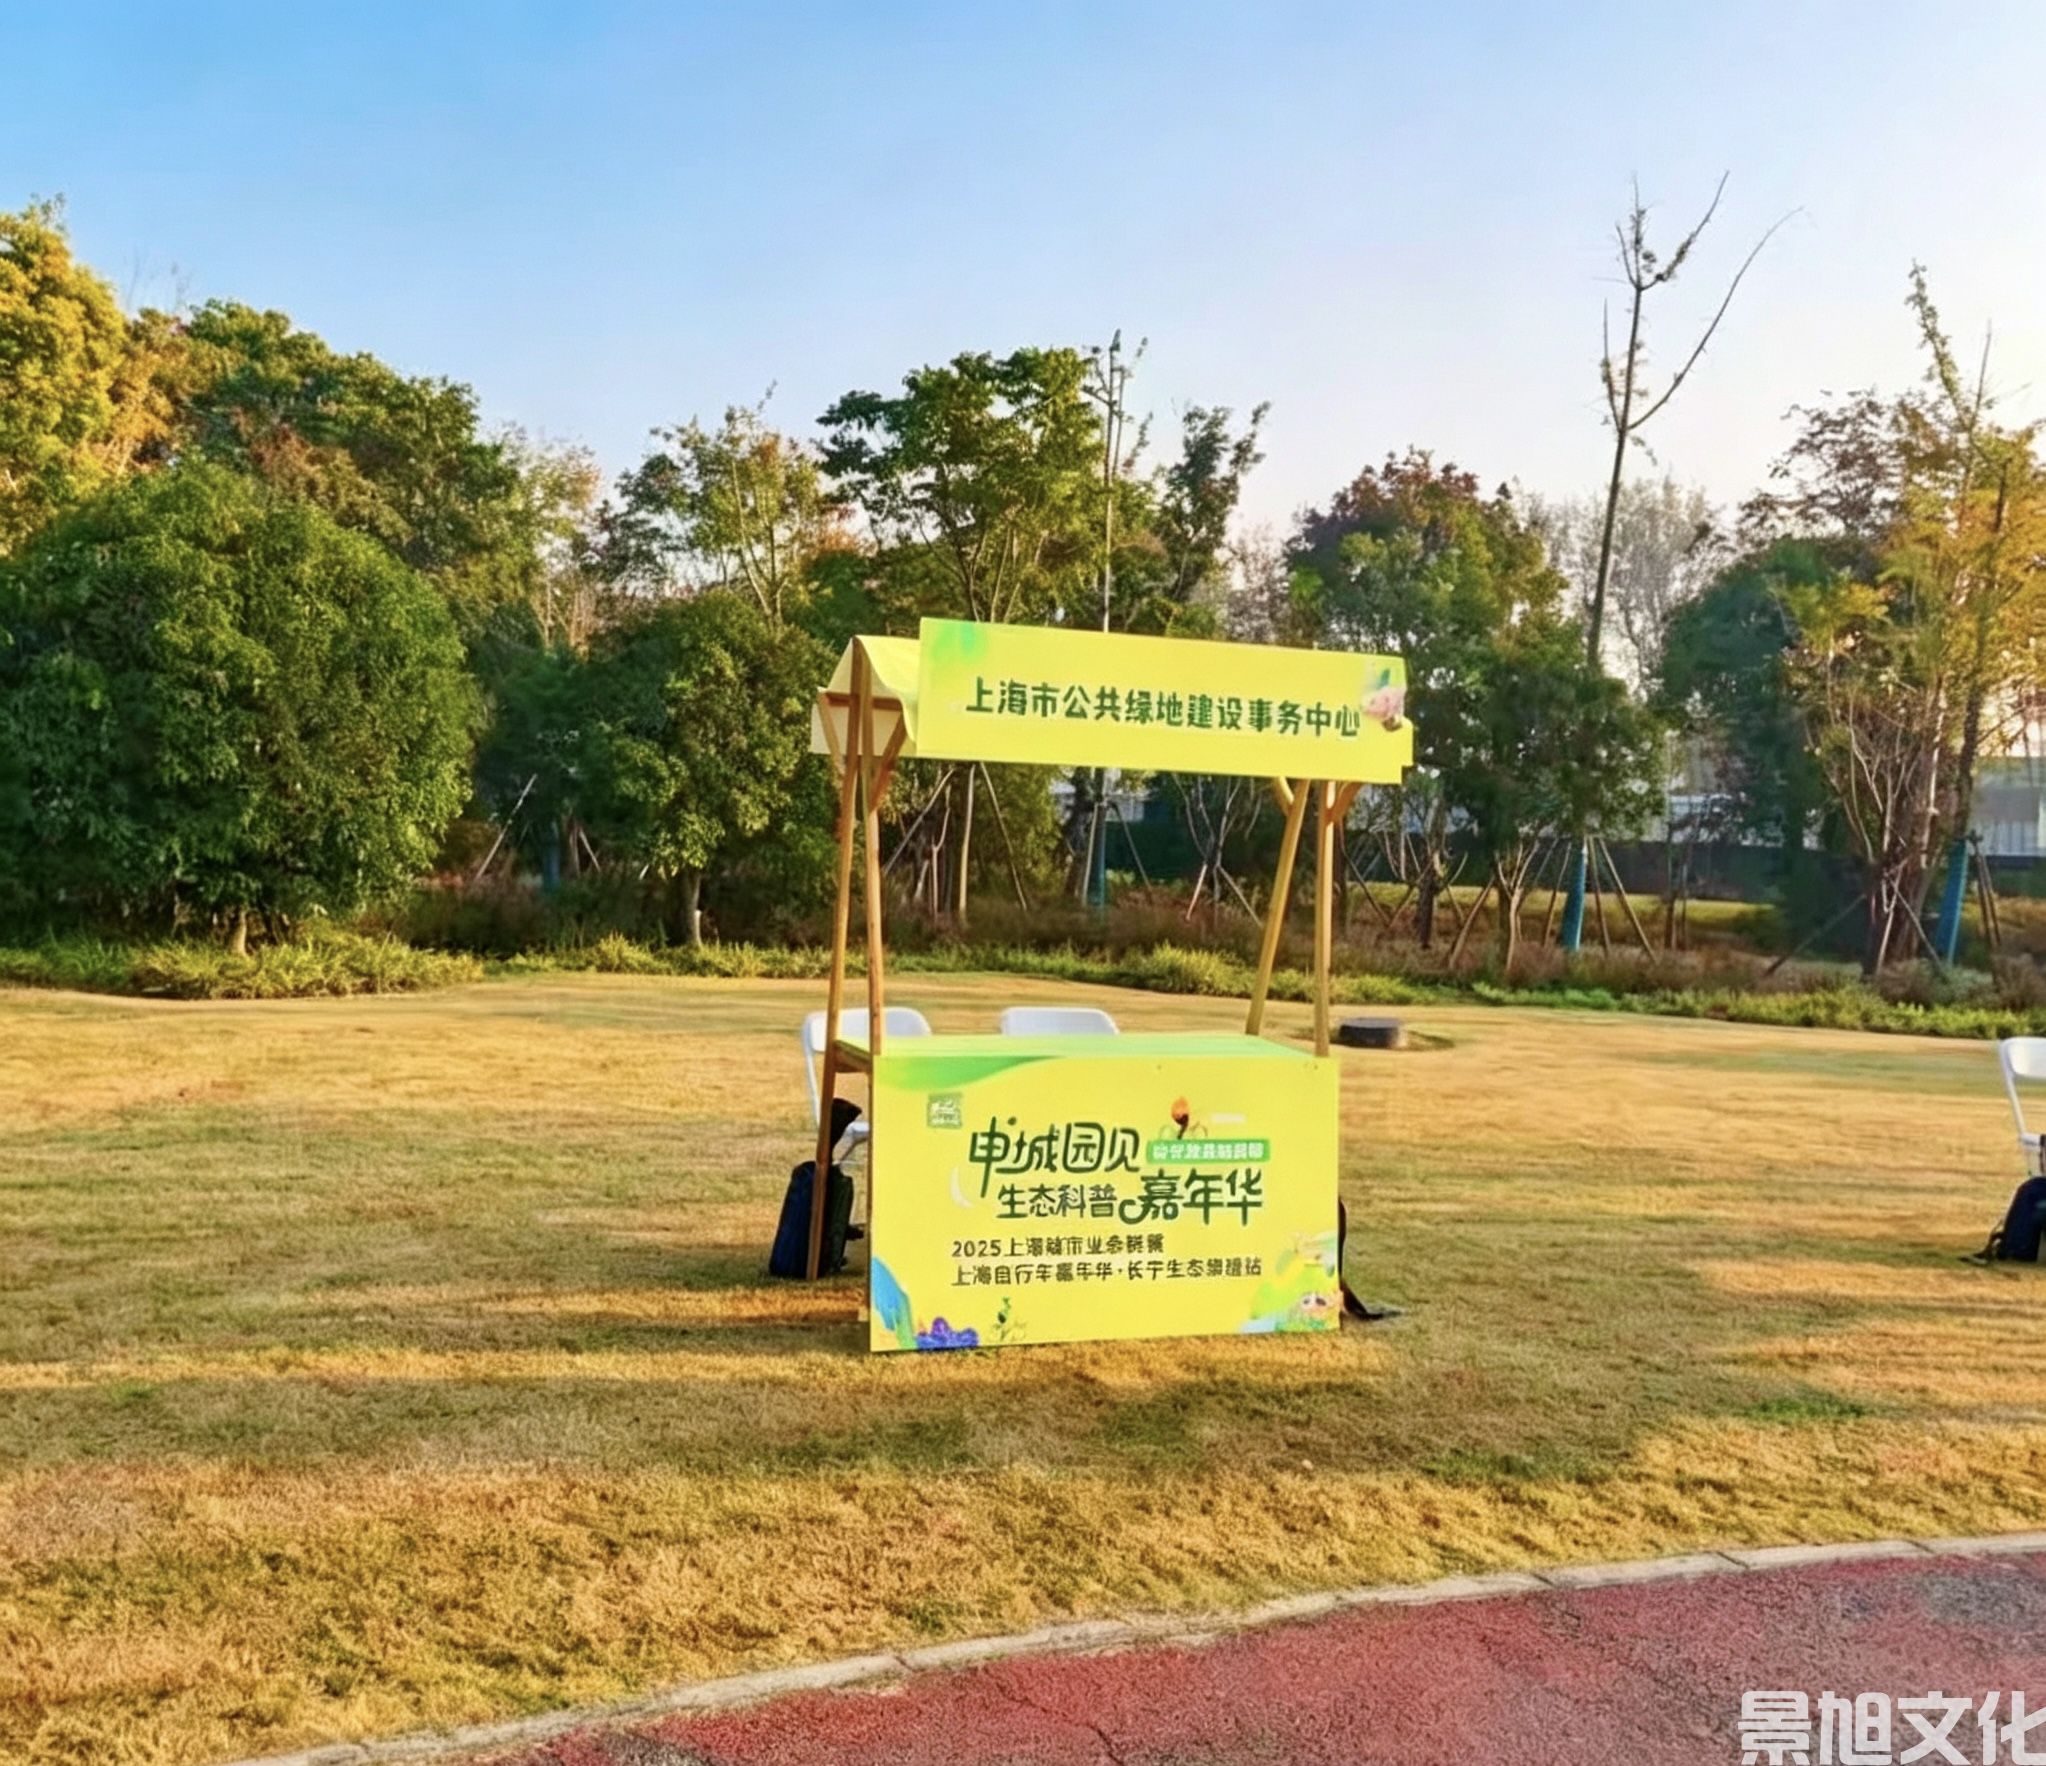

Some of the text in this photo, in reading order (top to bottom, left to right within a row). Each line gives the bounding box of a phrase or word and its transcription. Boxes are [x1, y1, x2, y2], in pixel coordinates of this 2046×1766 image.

[965, 676, 1360, 737] 上海市公共绿地建设事务中心
